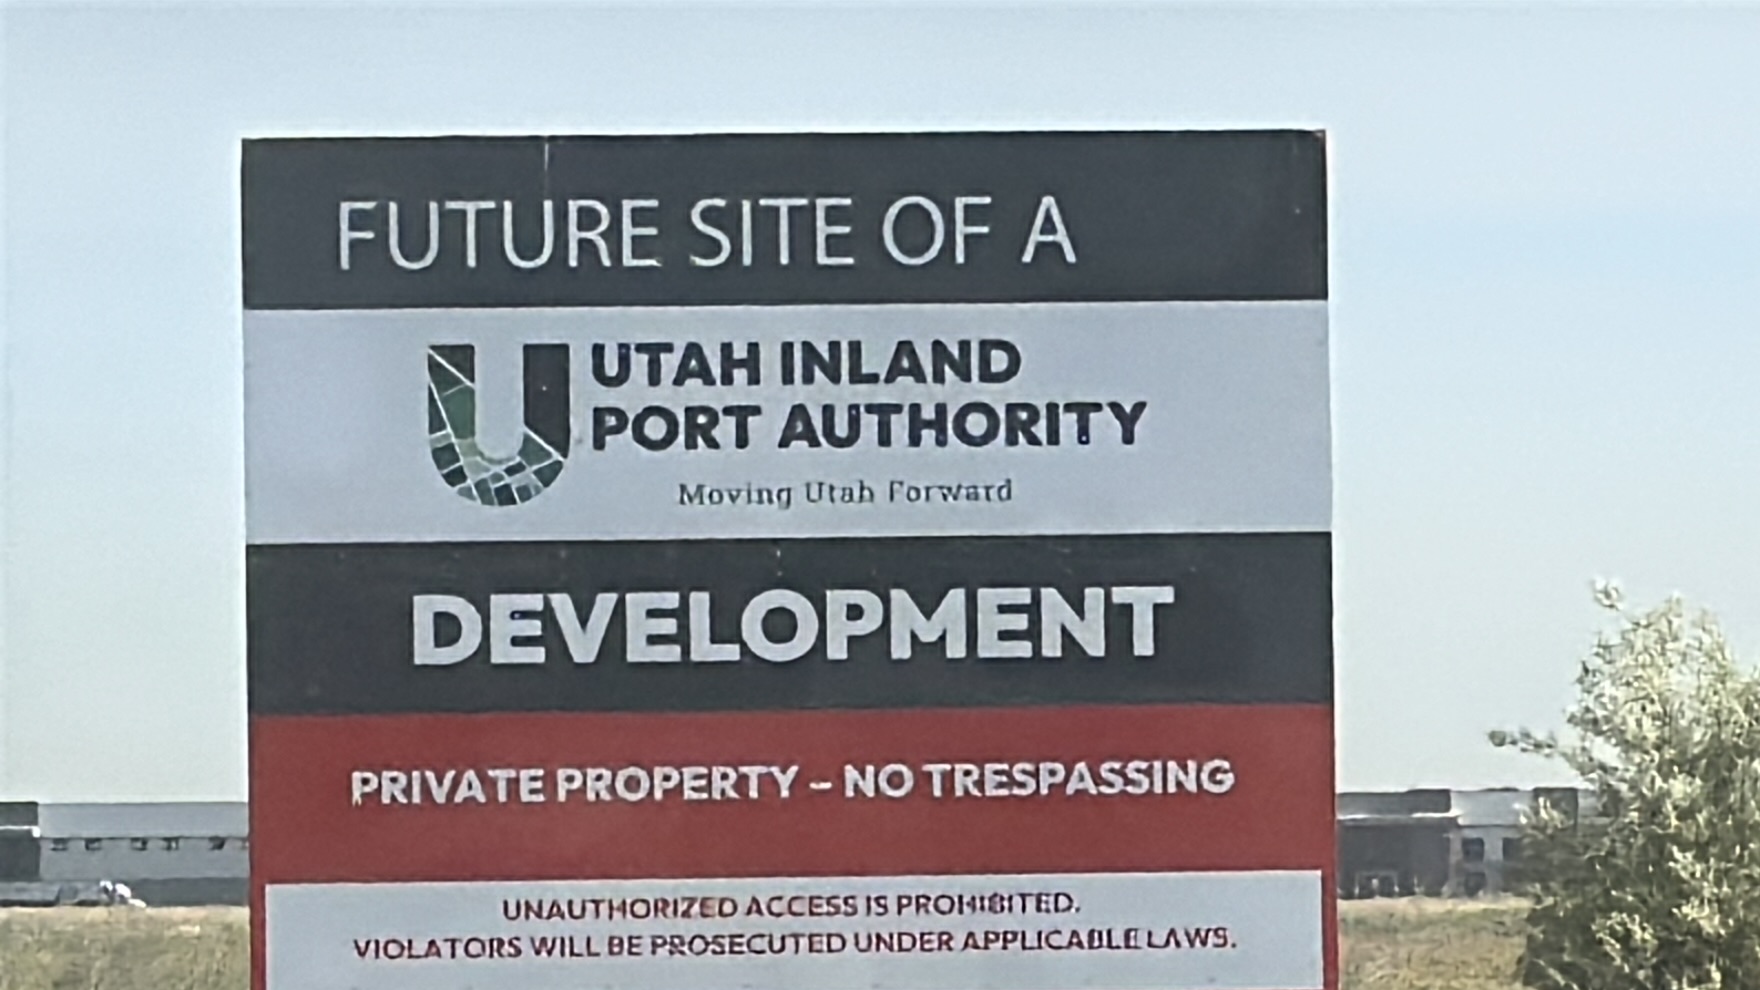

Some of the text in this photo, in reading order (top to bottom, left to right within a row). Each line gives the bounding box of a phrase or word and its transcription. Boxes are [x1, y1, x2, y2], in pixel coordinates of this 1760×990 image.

[340, 196, 1076, 269] FUTURE SITE OF A
[592, 339, 1021, 387] UTAH INLAND
[593, 401, 1147, 451] PORT AUTHORITY
[680, 479, 1011, 509] Moving Utah Forward
[413, 586, 1174, 664] DEVELOPMENT
[352, 769, 545, 804] PRIVATE
[557, 765, 798, 802] PROPERTY
[845, 764, 913, 797] NO
[922, 759, 1234, 797] TRESPASSING
[503, 892, 1080, 920] UNAUTHORIZED ACCESS IS PROHIBITED.
[354, 927, 1236, 959] VIOLATORS WILL BE PROSECUTED UNDER APPLICABLE LAWS.
